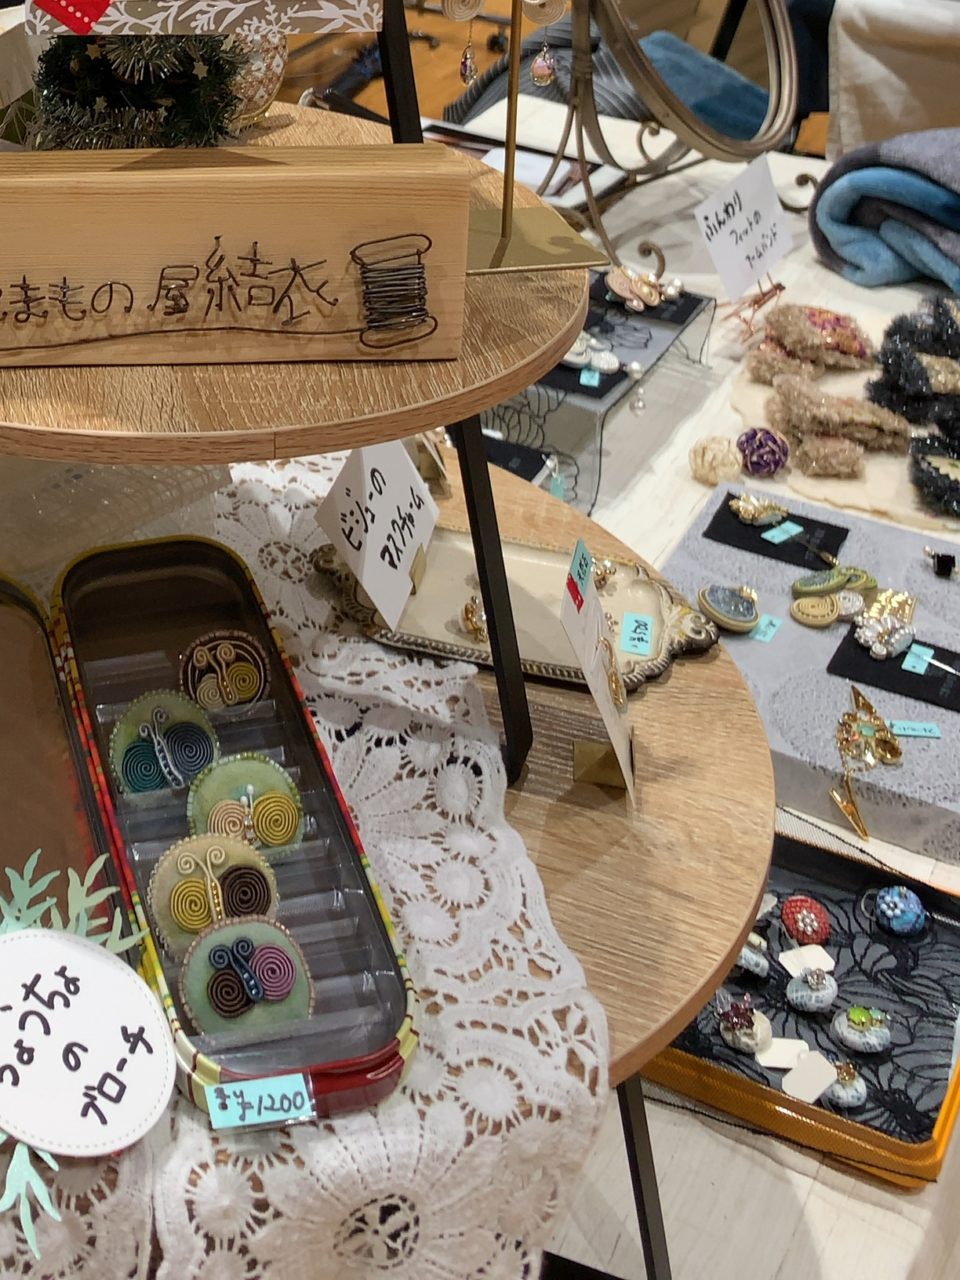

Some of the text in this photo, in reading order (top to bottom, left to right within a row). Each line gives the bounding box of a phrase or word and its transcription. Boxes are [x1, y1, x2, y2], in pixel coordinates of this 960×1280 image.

[704, 189, 743, 243] ふんわり
[341, 467, 387, 552] ビジューの
[61, 1041, 89, 1072] の
[80, 1025, 154, 1125] ブローチ
